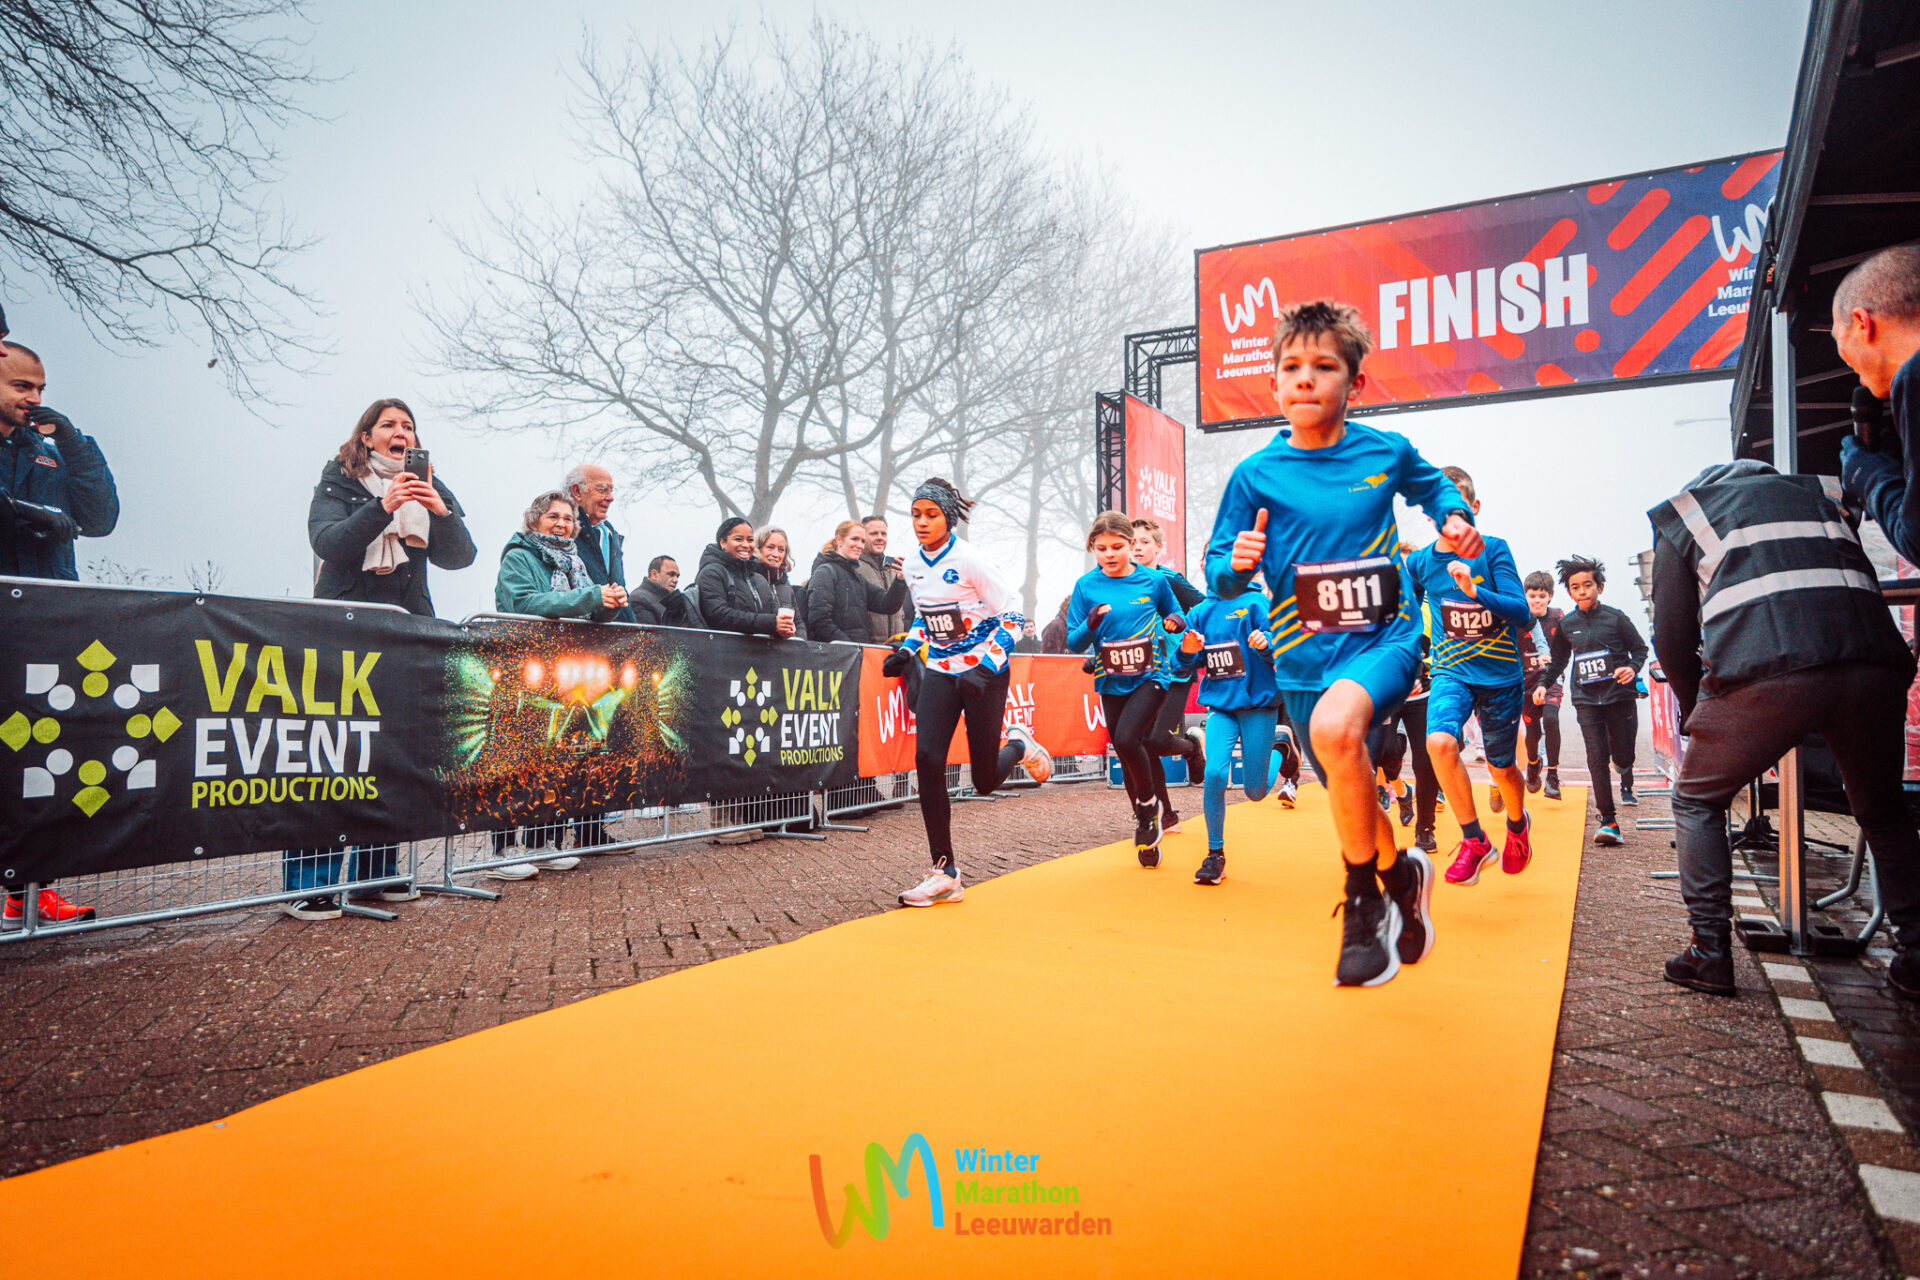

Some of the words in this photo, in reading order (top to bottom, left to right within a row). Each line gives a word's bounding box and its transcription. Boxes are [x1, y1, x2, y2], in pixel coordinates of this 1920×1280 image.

[1728, 266, 1757, 282] Win
[1379, 252, 1590, 350] FINISH
[1230, 336, 1270, 350] Winter
[1216, 360, 1276, 380] Leeuwarde
[1153, 468, 1177, 497] VALK
[1316, 573, 1383, 612] 8111
[1449, 609, 1493, 629] 8120
[1109, 646, 1146, 666] 8119
[1206, 650, 1234, 669] 8110
[1578, 658, 1607, 675] 8113
[194, 639, 383, 717] VALK
[782, 667, 843, 711] VALK
[1003, 682, 1036, 708] ALK
[1001, 706, 1036, 729] VENT
[779, 712, 841, 748] EVENT
[194, 717, 381, 778] EVENT
[780, 745, 844, 766] PRODUCTIONS
[191, 776, 379, 809] PRODUCTIONS
